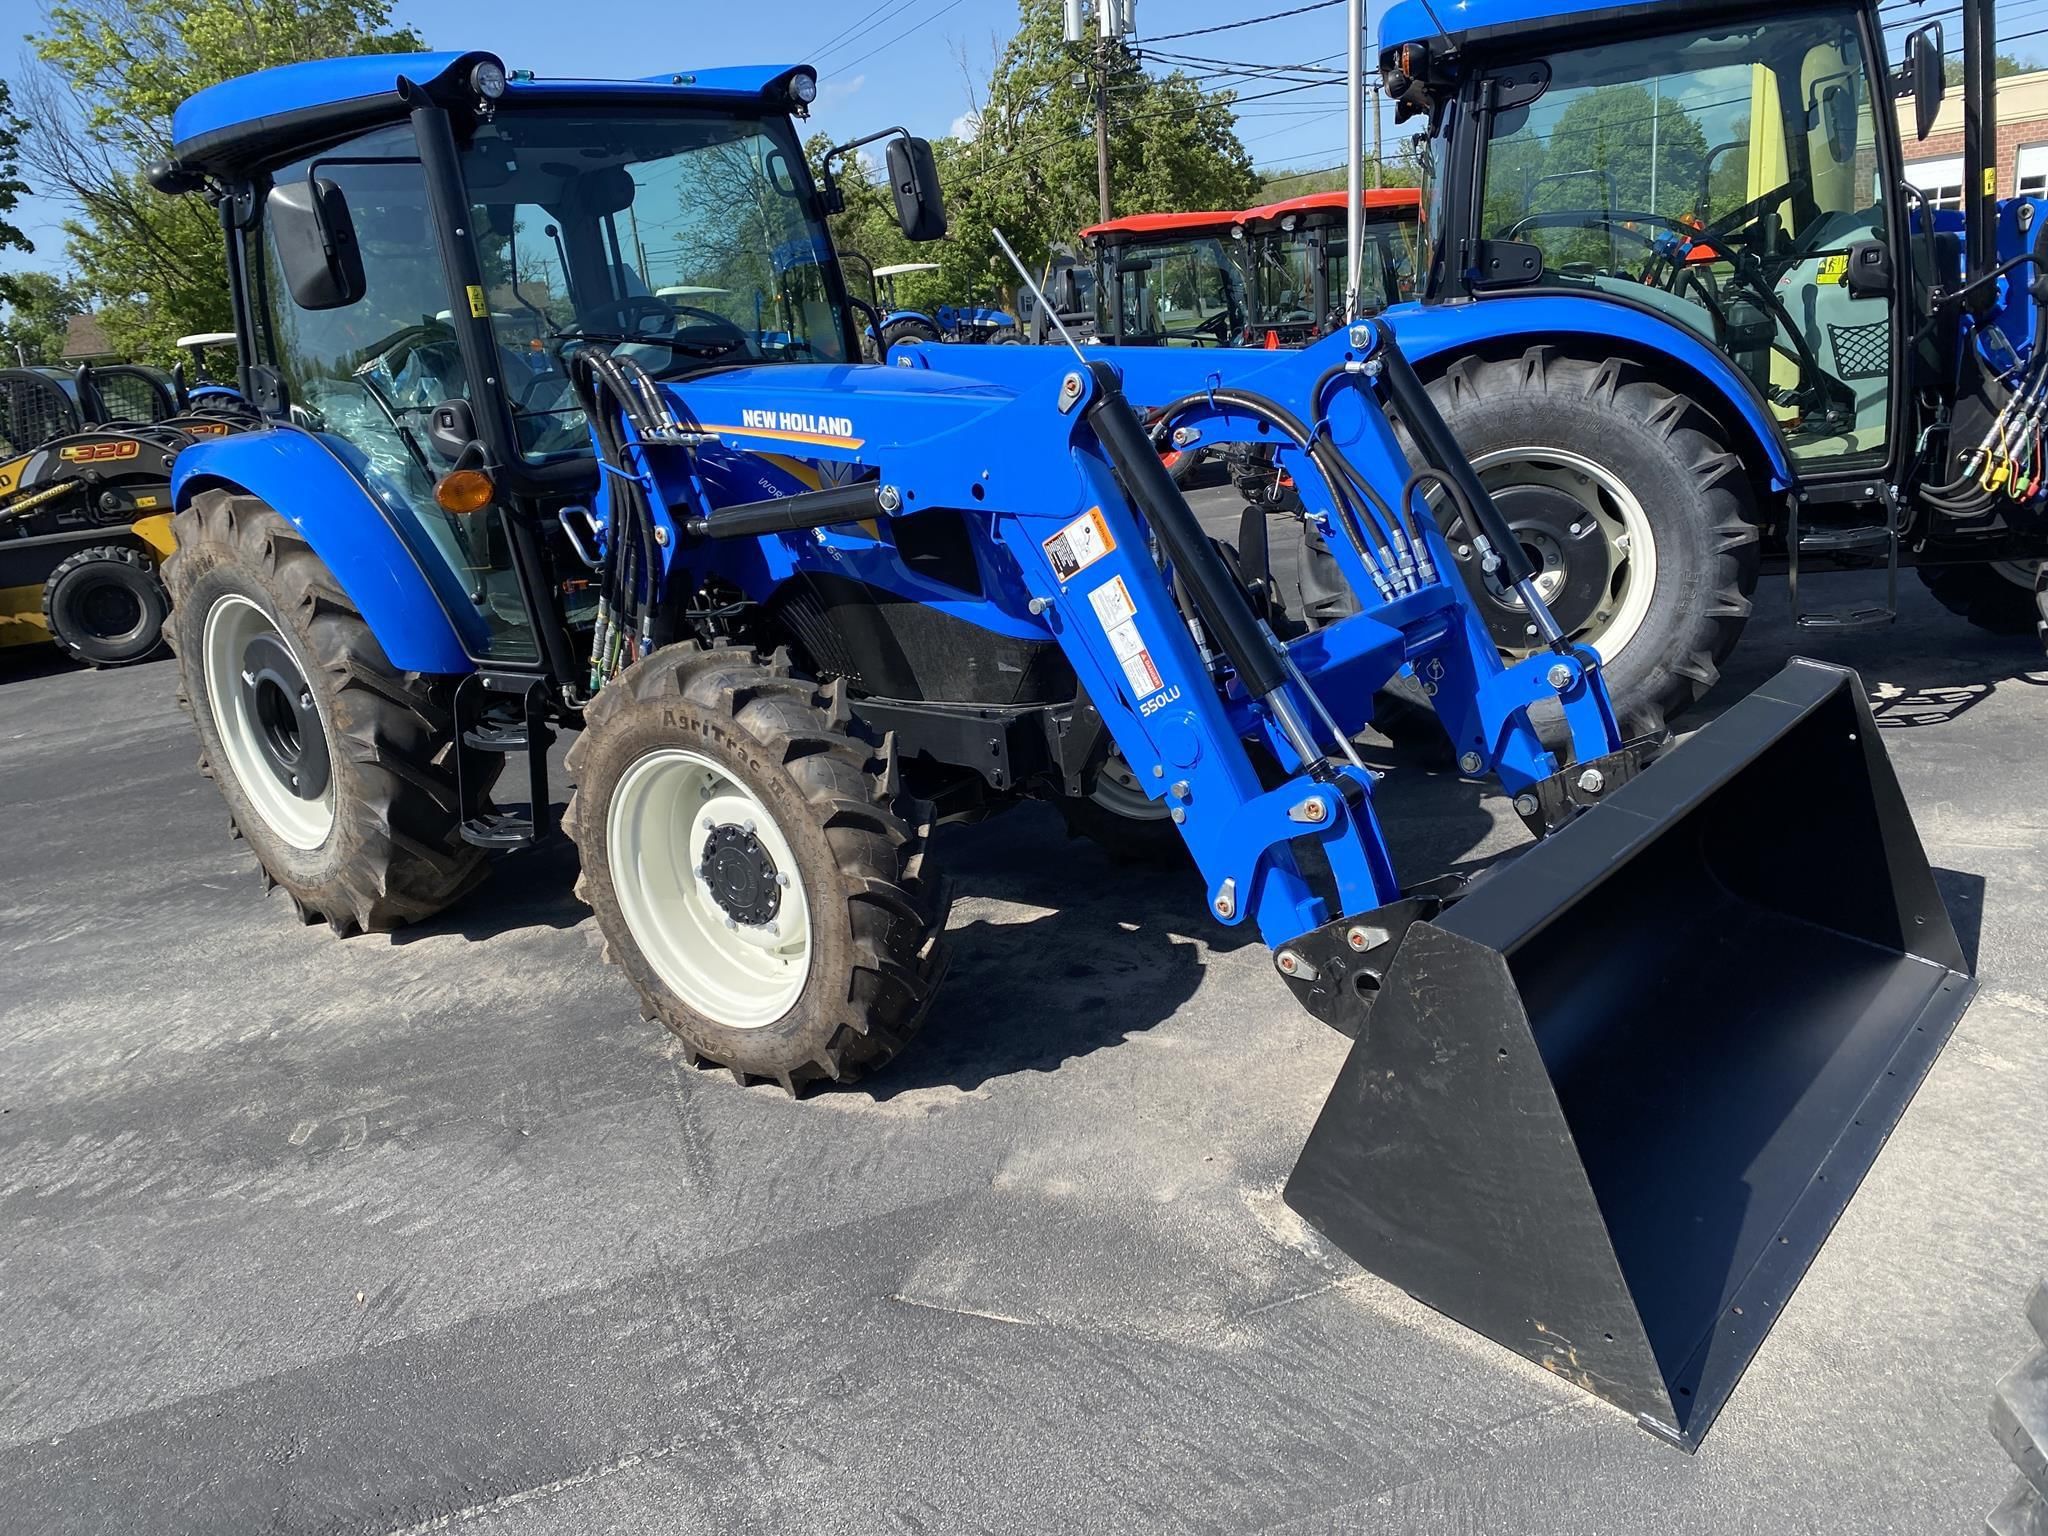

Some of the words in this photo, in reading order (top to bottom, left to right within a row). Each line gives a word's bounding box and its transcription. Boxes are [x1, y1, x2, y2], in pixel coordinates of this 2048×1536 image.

[742, 409, 777, 429] NEW
[779, 411, 853, 437] HOLLAND
[826, 545, 843, 561] 65
[1144, 660, 1160, 687] DANGER
[1139, 684, 1181, 717] 550LU
[663, 710, 761, 773] AgriTrac
